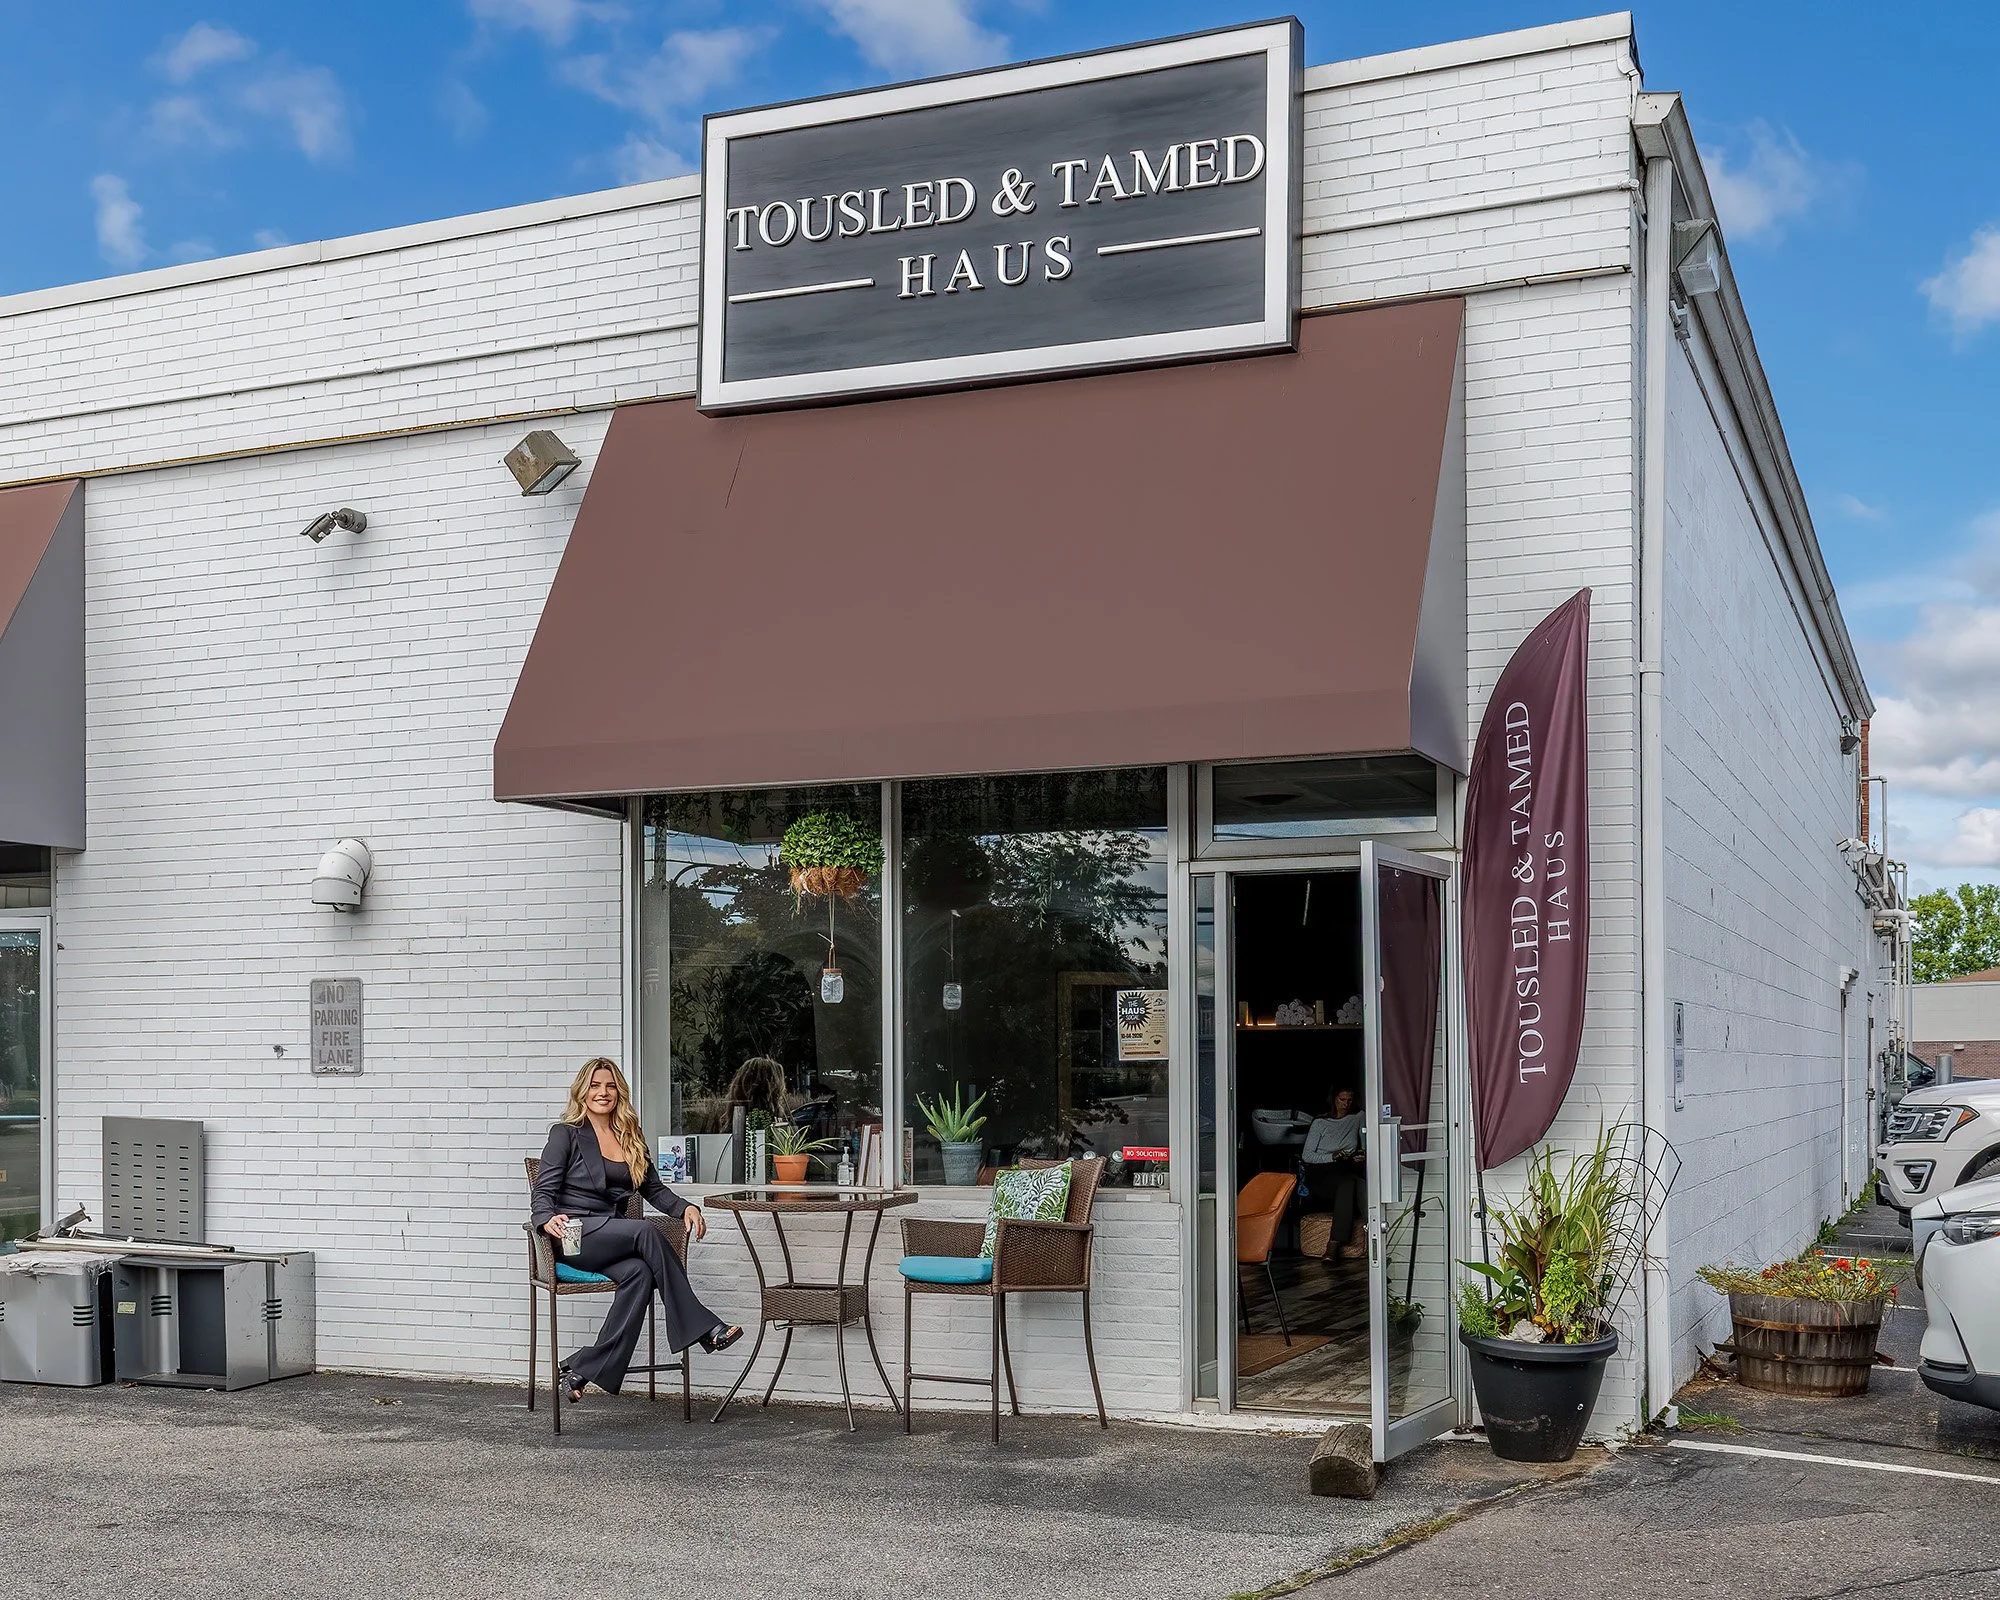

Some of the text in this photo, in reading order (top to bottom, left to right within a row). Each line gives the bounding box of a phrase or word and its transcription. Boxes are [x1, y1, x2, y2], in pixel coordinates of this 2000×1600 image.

[726, 133, 1267, 252] TOUSLED & TAMED
[897, 234, 1073, 299] HAUS
[1505, 701, 1547, 1084] TOUSLED & TAMED
[1544, 830, 1571, 943] HAUS
[326, 985, 345, 1004] NO
[314, 1009, 358, 1026] PARKING
[1121, 1007, 1146, 1015] HAUS
[322, 1031, 350, 1046] FIRE
[319, 1049, 353, 1065] LANE
[1133, 1172, 1164, 1186] 2010
